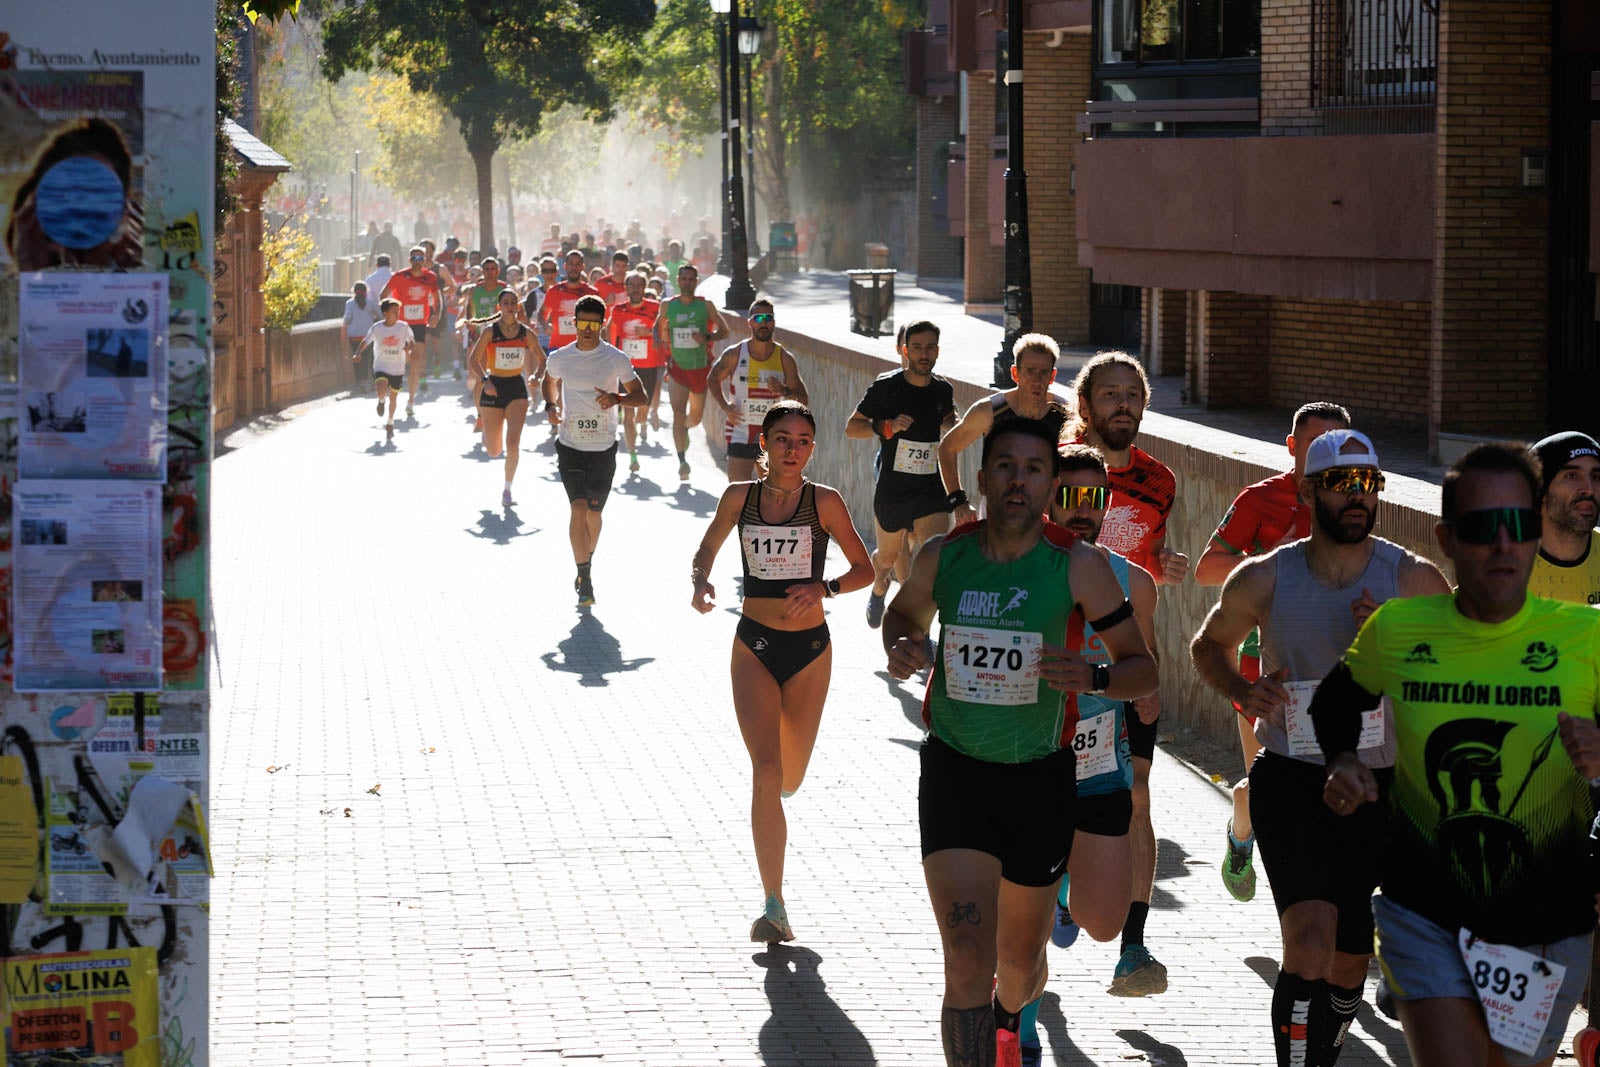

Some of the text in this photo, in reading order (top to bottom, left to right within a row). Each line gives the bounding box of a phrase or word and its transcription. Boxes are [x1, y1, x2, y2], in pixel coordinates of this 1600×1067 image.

[92, 49, 200, 67] Ayuntamiento
[501, 352, 520, 360] 1064
[749, 404, 768, 413] 542
[577, 419, 598, 429] 939
[908, 448, 930, 460] 736
[751, 538, 799, 555] 1177
[957, 589, 1001, 618] ATARFE
[956, 615, 1025, 628] Atletismo Atarfe
[958, 644, 1023, 671] 1270
[976, 671, 1006, 681] ANTONIO
[1401, 680, 1562, 707] TRIATLÓN LORCA
[92, 741, 130, 752] OFERTA
[13, 964, 130, 995] MOLINA
[1474, 960, 1528, 1002] 893
[17, 1012, 81, 1029] OFERTON
[92, 1000, 139, 1054] B
[18, 1029, 81, 1045] PERMISO
